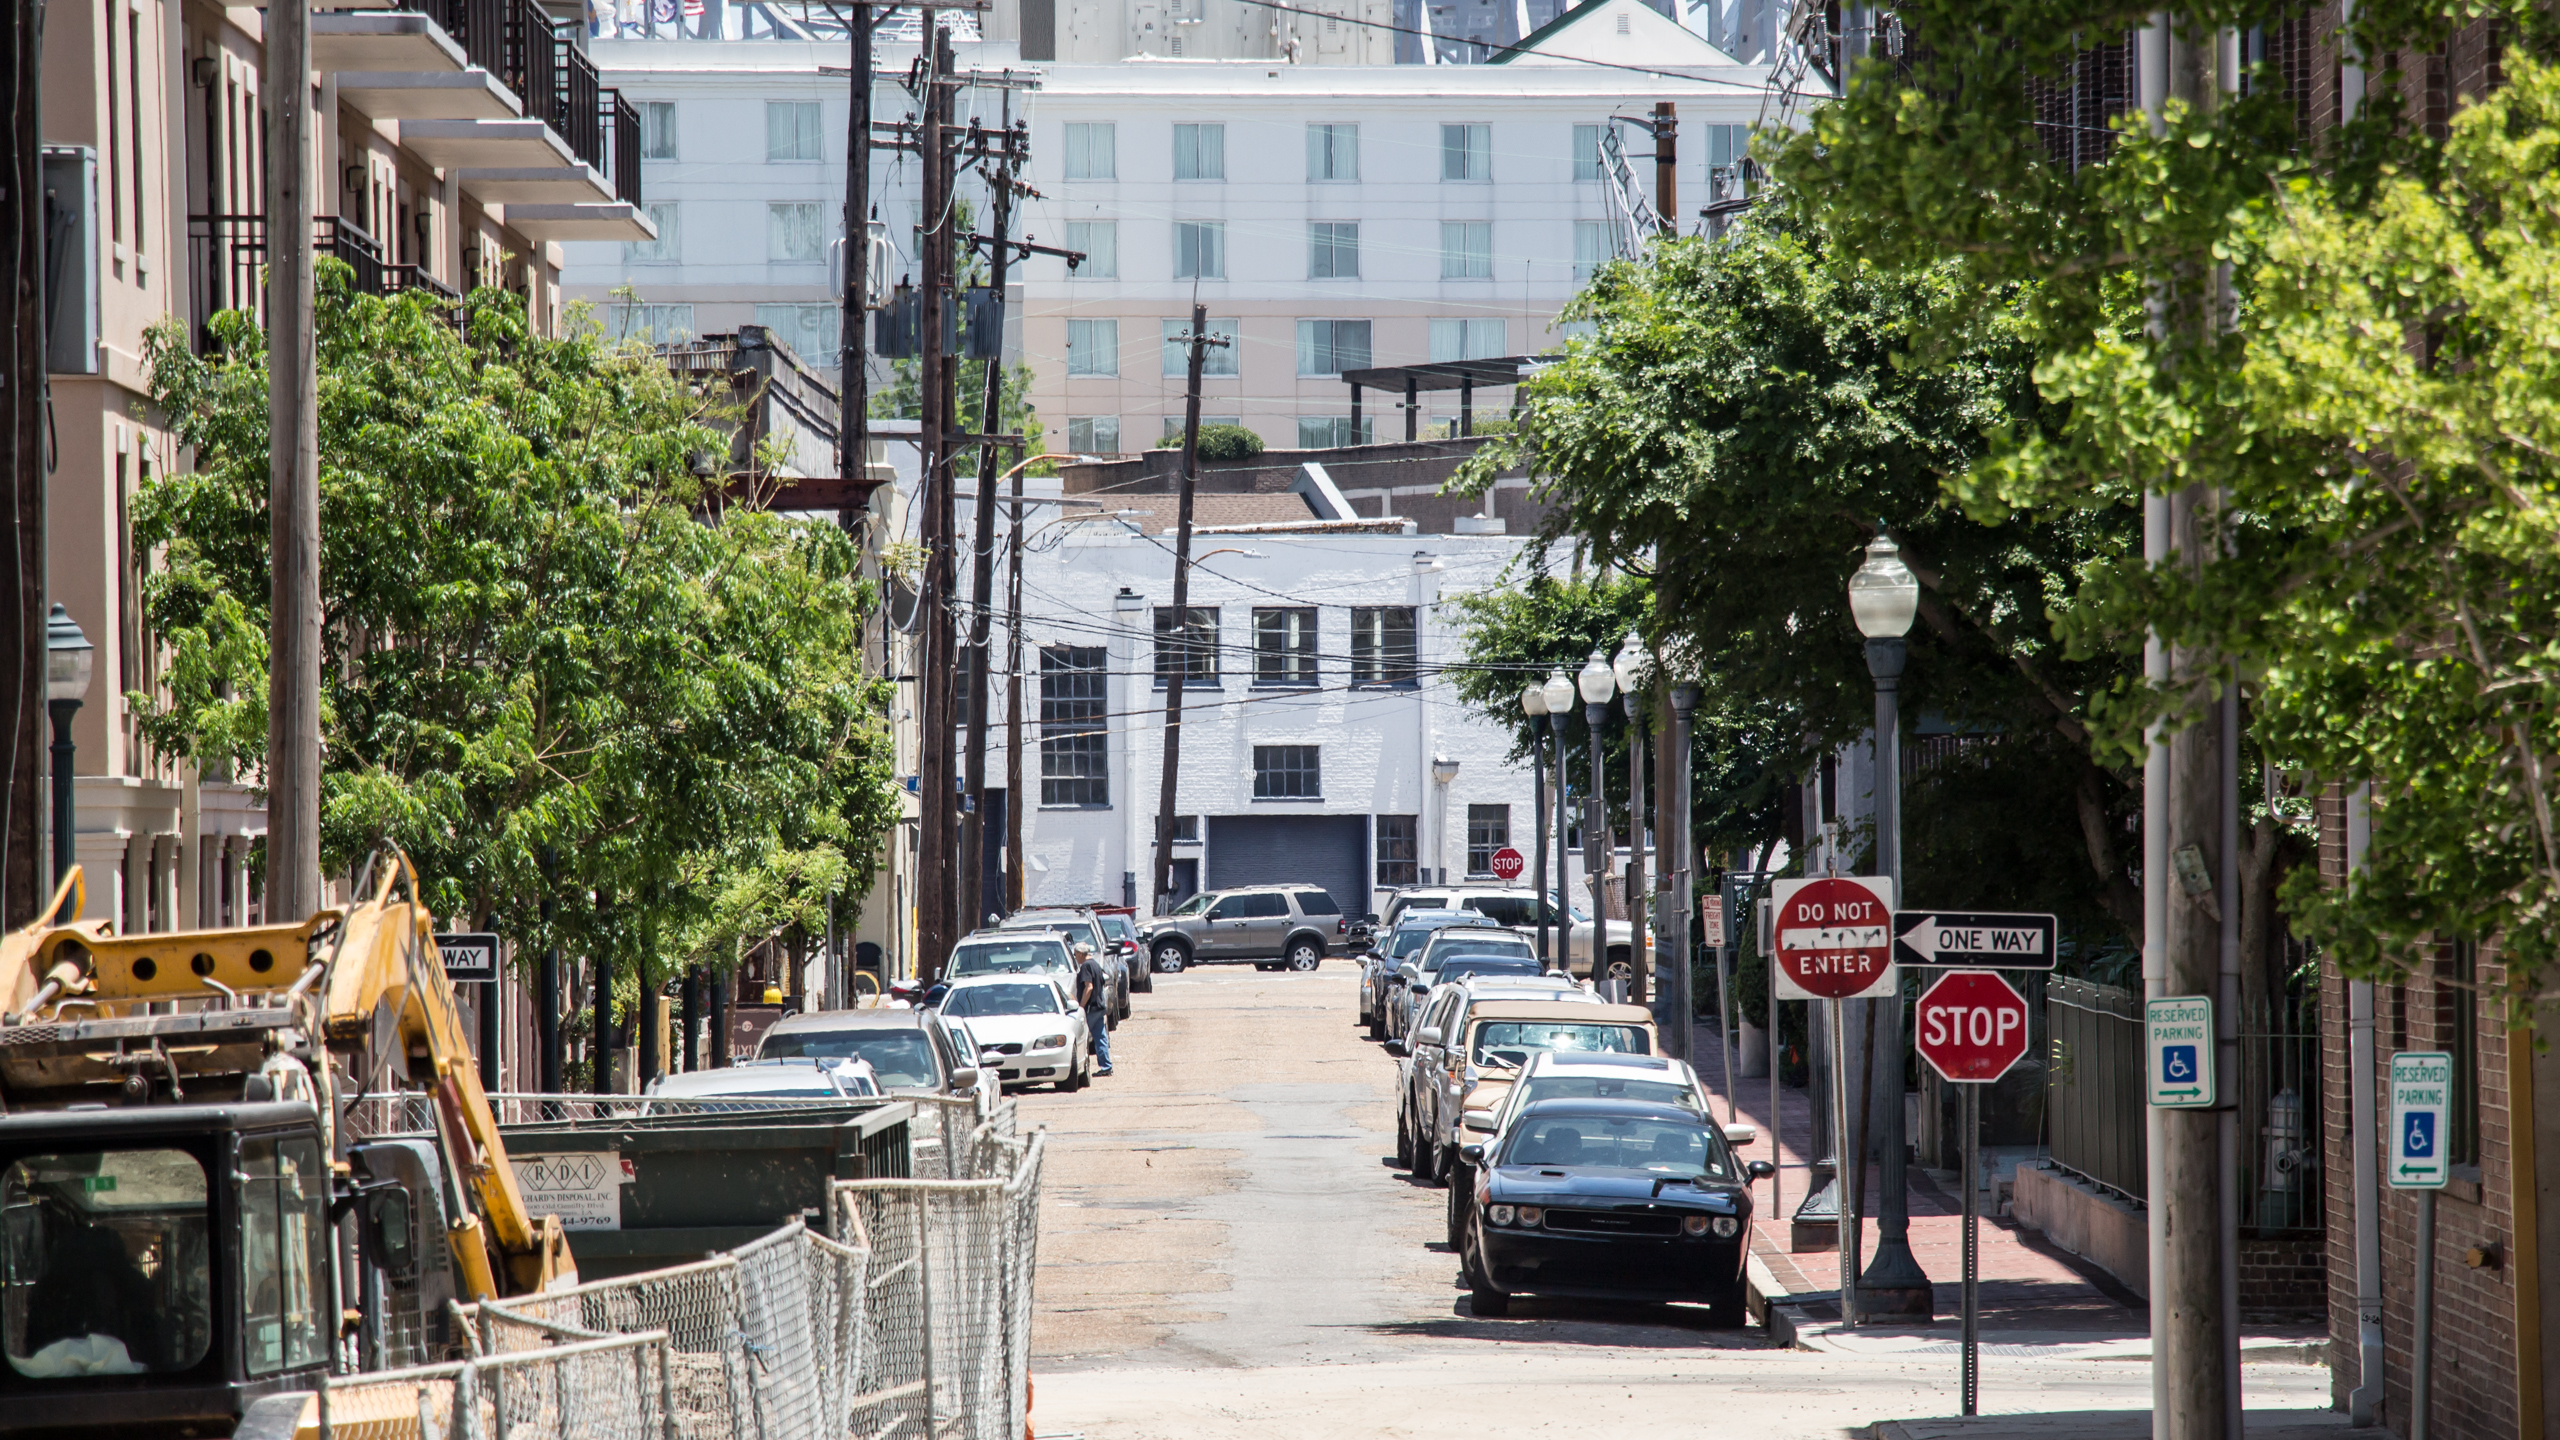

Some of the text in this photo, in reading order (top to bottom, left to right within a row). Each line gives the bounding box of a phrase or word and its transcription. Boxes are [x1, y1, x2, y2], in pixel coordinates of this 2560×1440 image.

[1494, 857, 1522, 870] STOP
[1706, 911, 1720, 920] FREIGHT
[1798, 902, 1873, 922] DO NOT
[1709, 921, 1719, 930] ZONE
[1939, 929, 2037, 951] ONE WAY
[442, 949, 482, 966] WAY
[1800, 955, 1871, 975] ENTER
[422, 935, 458, 1052] GEHL
[2149, 1008, 2206, 1023] RESERVED
[1924, 1006, 2020, 1047] STOP
[2154, 1027, 2203, 1041] PARKING
[2394, 1066, 2446, 1083] RESERVED
[2397, 1089, 2442, 1105] PARKING
[522, 1194, 555, 1202] CHARD'S
[597, 1192, 613, 1201] INC.
[560, 1217, 611, 1225] 44-9769
